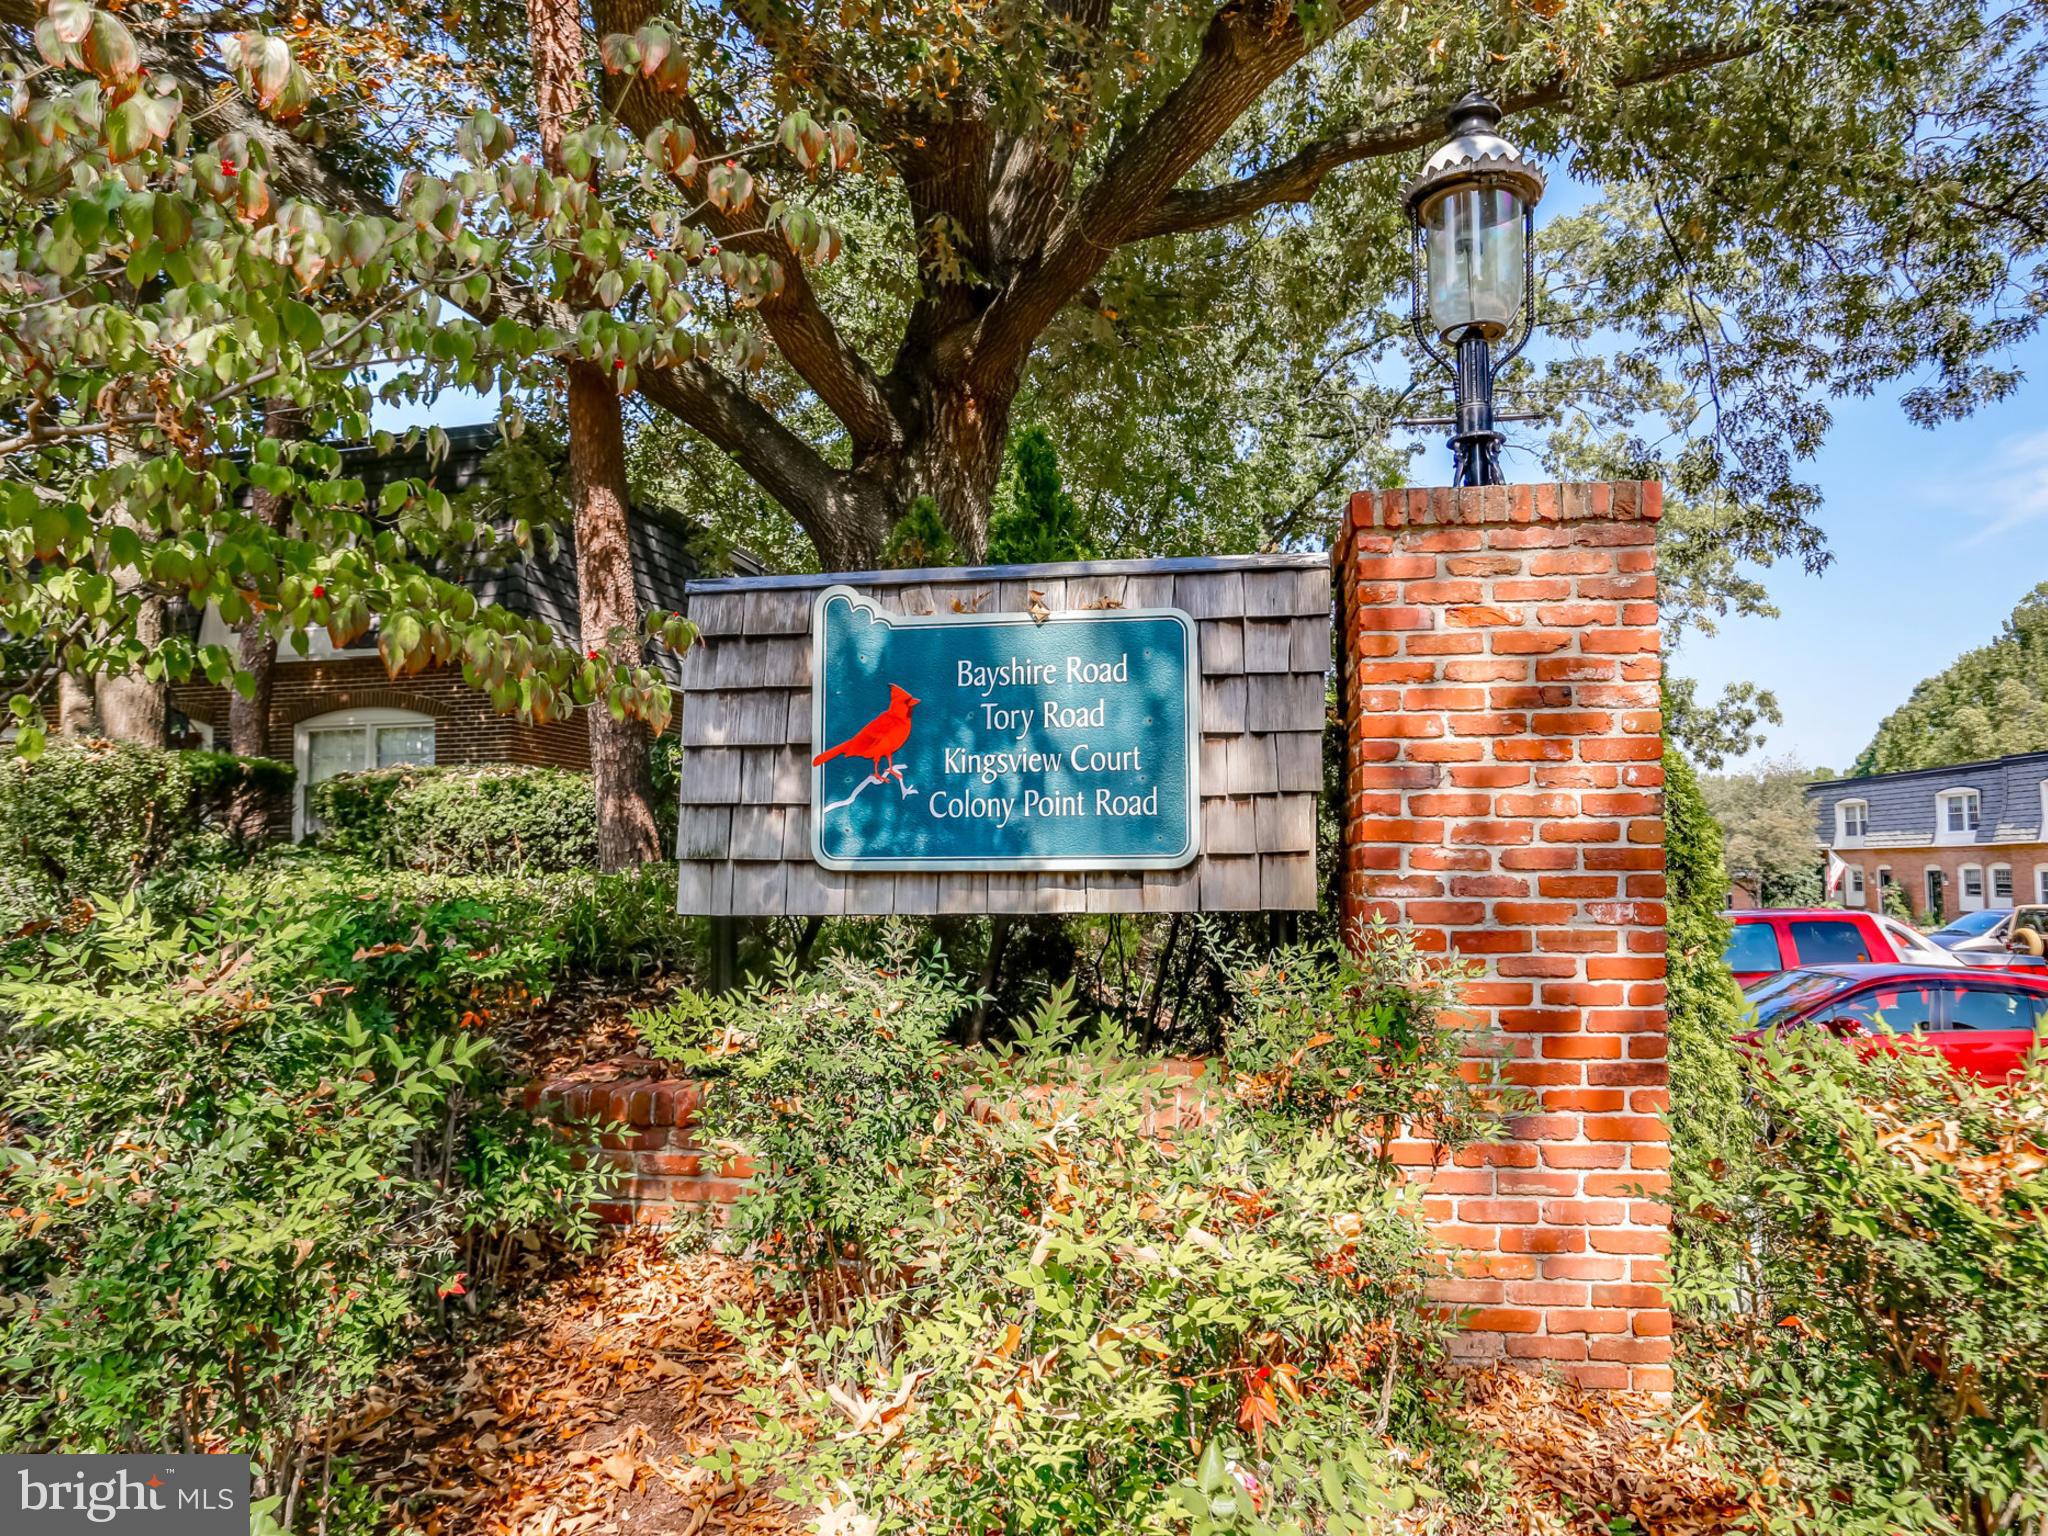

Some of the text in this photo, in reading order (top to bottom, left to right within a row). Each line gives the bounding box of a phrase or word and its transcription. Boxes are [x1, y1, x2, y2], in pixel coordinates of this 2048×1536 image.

[957, 653, 1128, 697] Bayshire Road
[980, 699, 1105, 740] Tory Road
[944, 744, 1142, 784] Kingsview Court
[929, 786, 1159, 828] Colony Point Road
